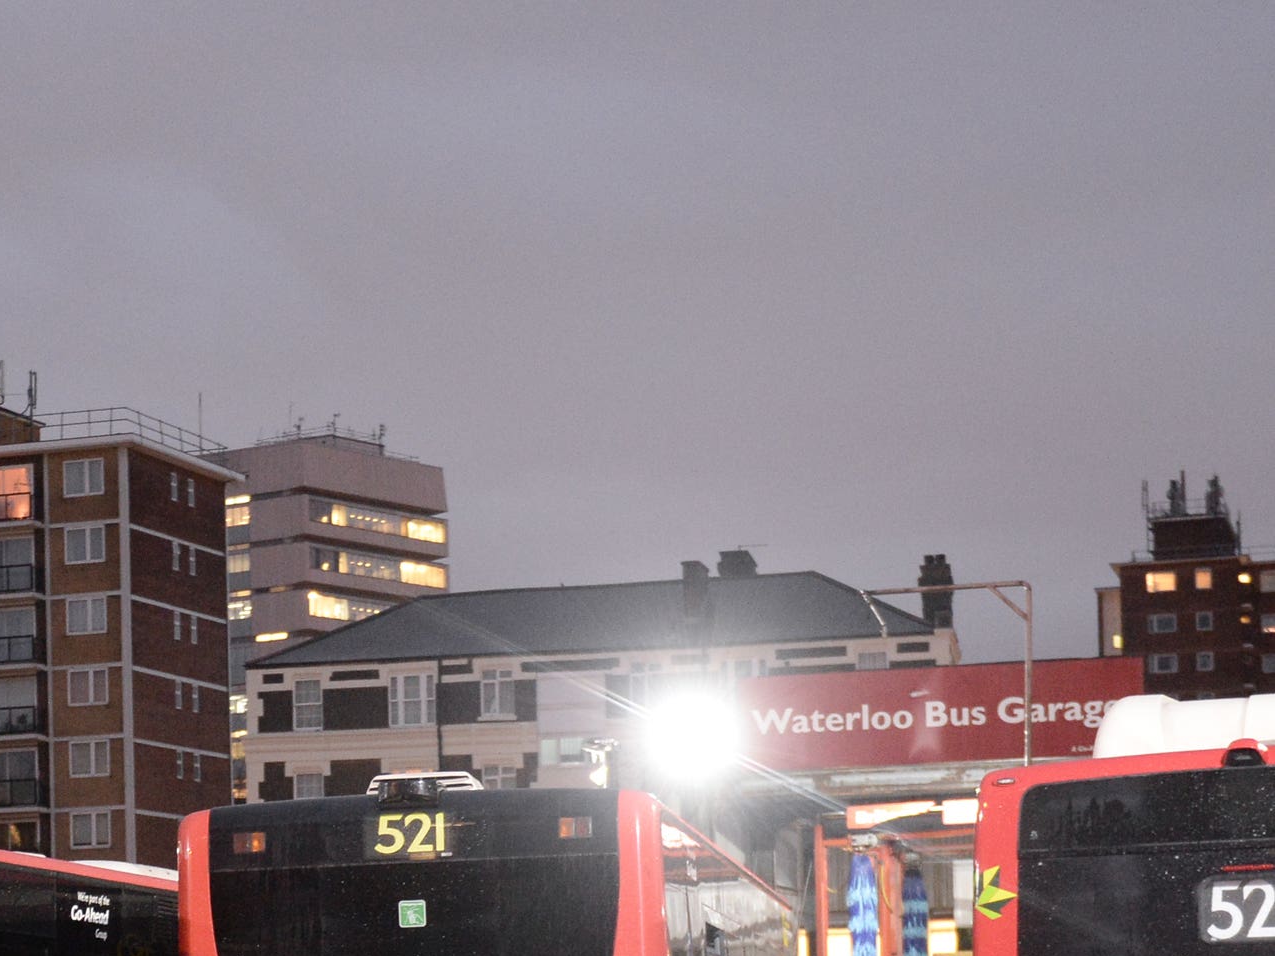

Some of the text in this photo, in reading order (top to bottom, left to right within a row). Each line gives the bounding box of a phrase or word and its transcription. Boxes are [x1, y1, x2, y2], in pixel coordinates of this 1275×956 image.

[750, 703, 914, 735] Waterloo
[924, 700, 987, 728] Bus
[374, 812, 445, 855] 521
[70, 904, 110, 926] Go-Ahead
